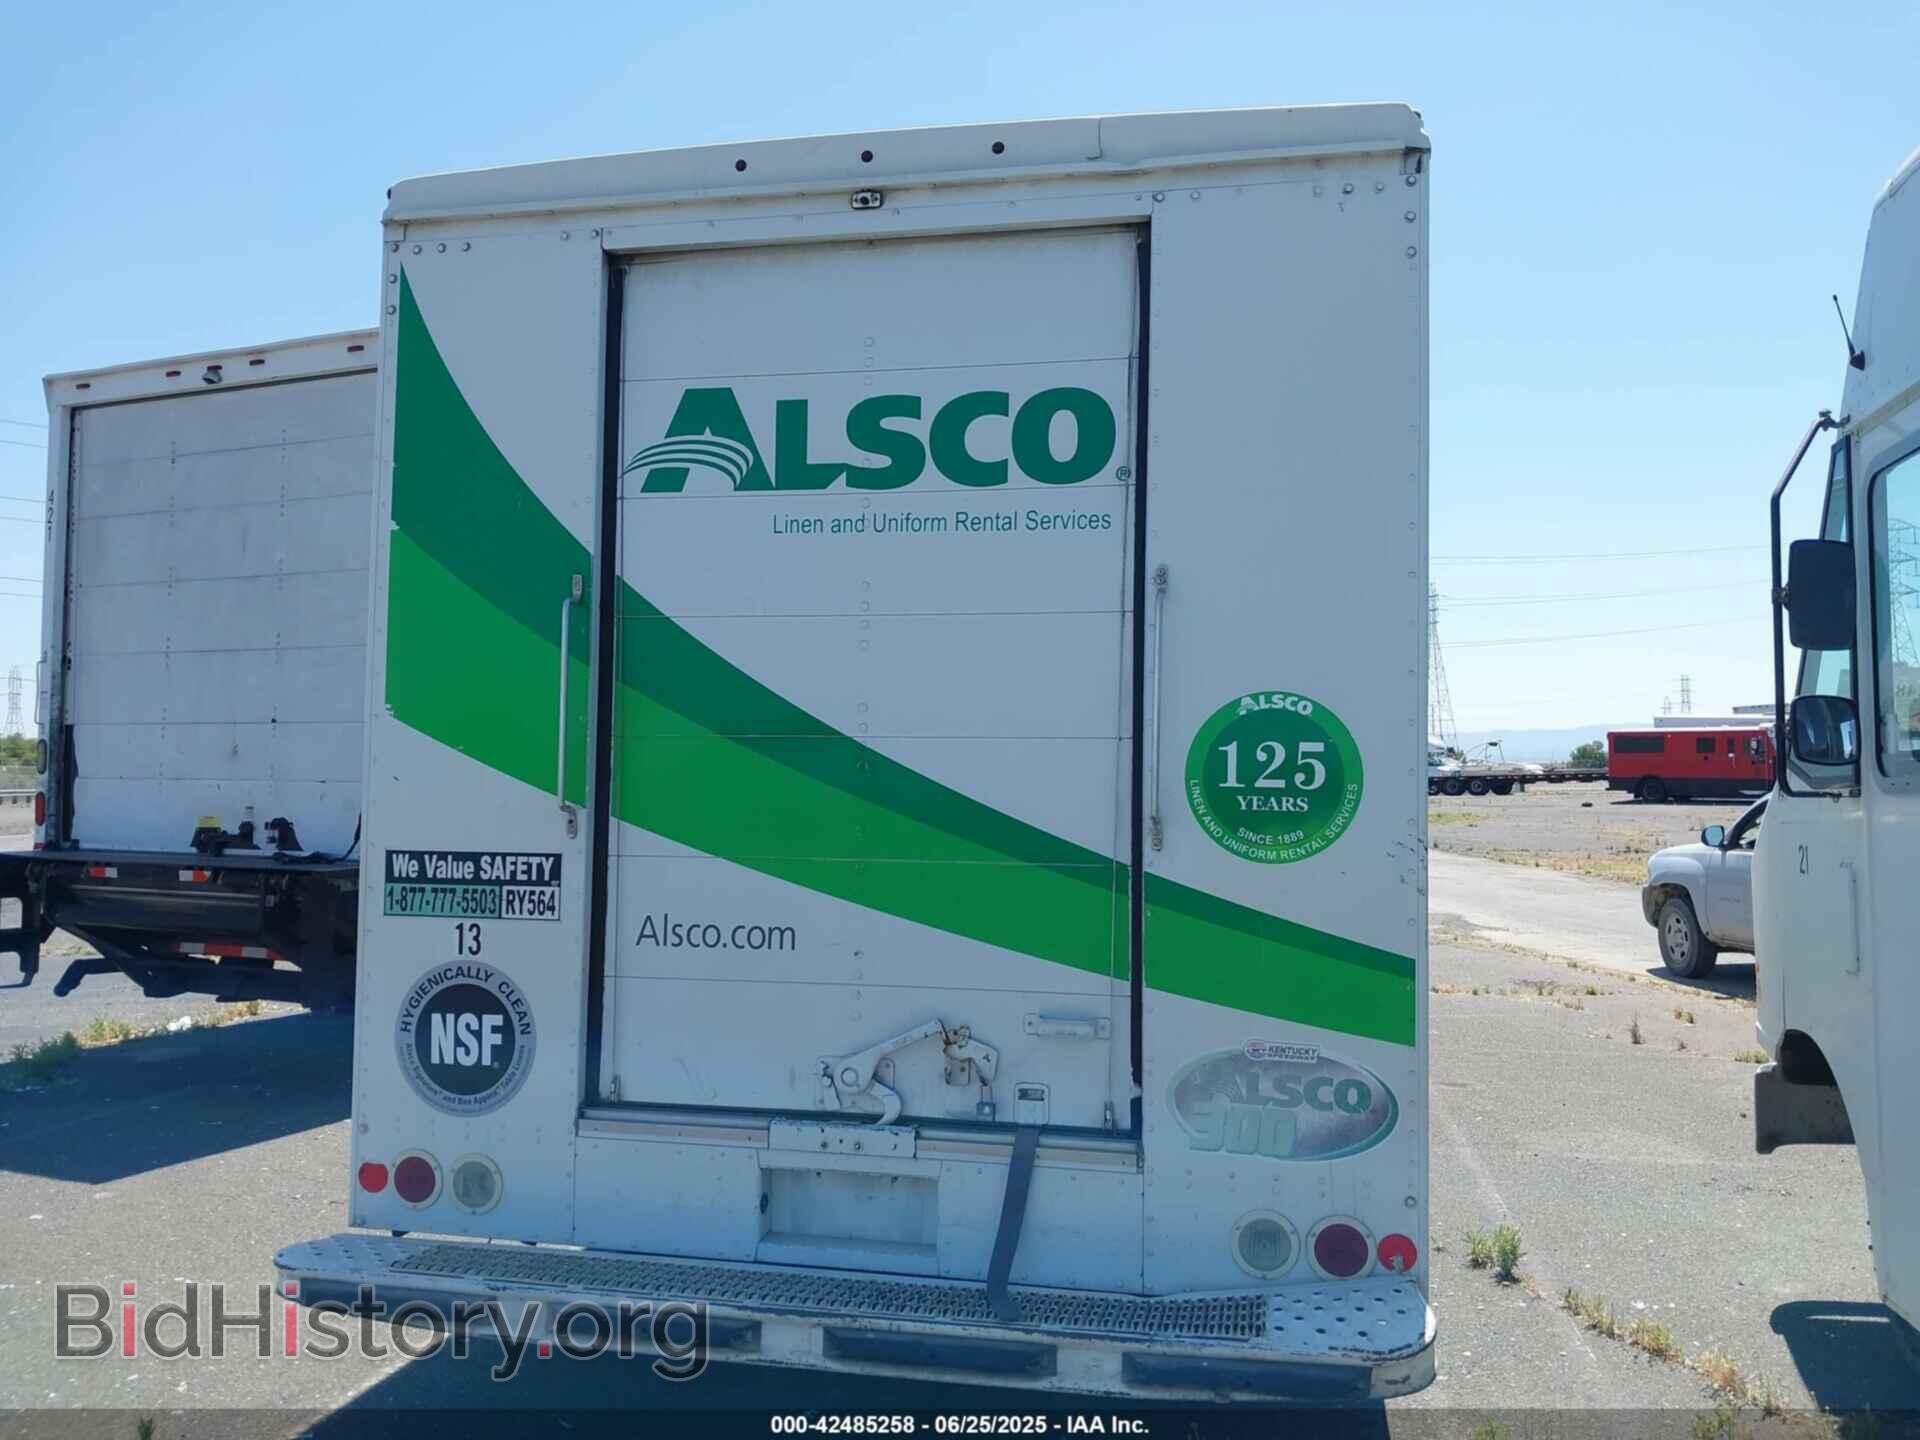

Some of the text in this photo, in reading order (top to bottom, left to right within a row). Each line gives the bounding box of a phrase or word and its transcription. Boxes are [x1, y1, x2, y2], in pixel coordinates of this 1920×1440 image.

[618, 386, 1117, 493] ALSCO
[773, 510, 1112, 534] Linen and Uniform Rental Services
[1237, 695, 1313, 716] ALSCO
[1218, 741, 1326, 790] 125
[1237, 796, 1309, 812] YEARS
[1189, 780, 1358, 860] LINEN AND UNIFORM RENTAL SERVICES
[1237, 827, 1304, 845] SINCE 1889
[392, 854, 554, 881] We Value SAFETY
[387, 885, 497, 914] 1-877-777-5503
[505, 889, 556, 917] RY564
[455, 922, 481, 955] 13
[635, 913, 796, 950] Alsco.com
[400, 965, 532, 1035] HYGIENICALLY CLEAN
[430, 1012, 504, 1066] NSF
[1268, 1045, 1318, 1056] KENTUCKY
